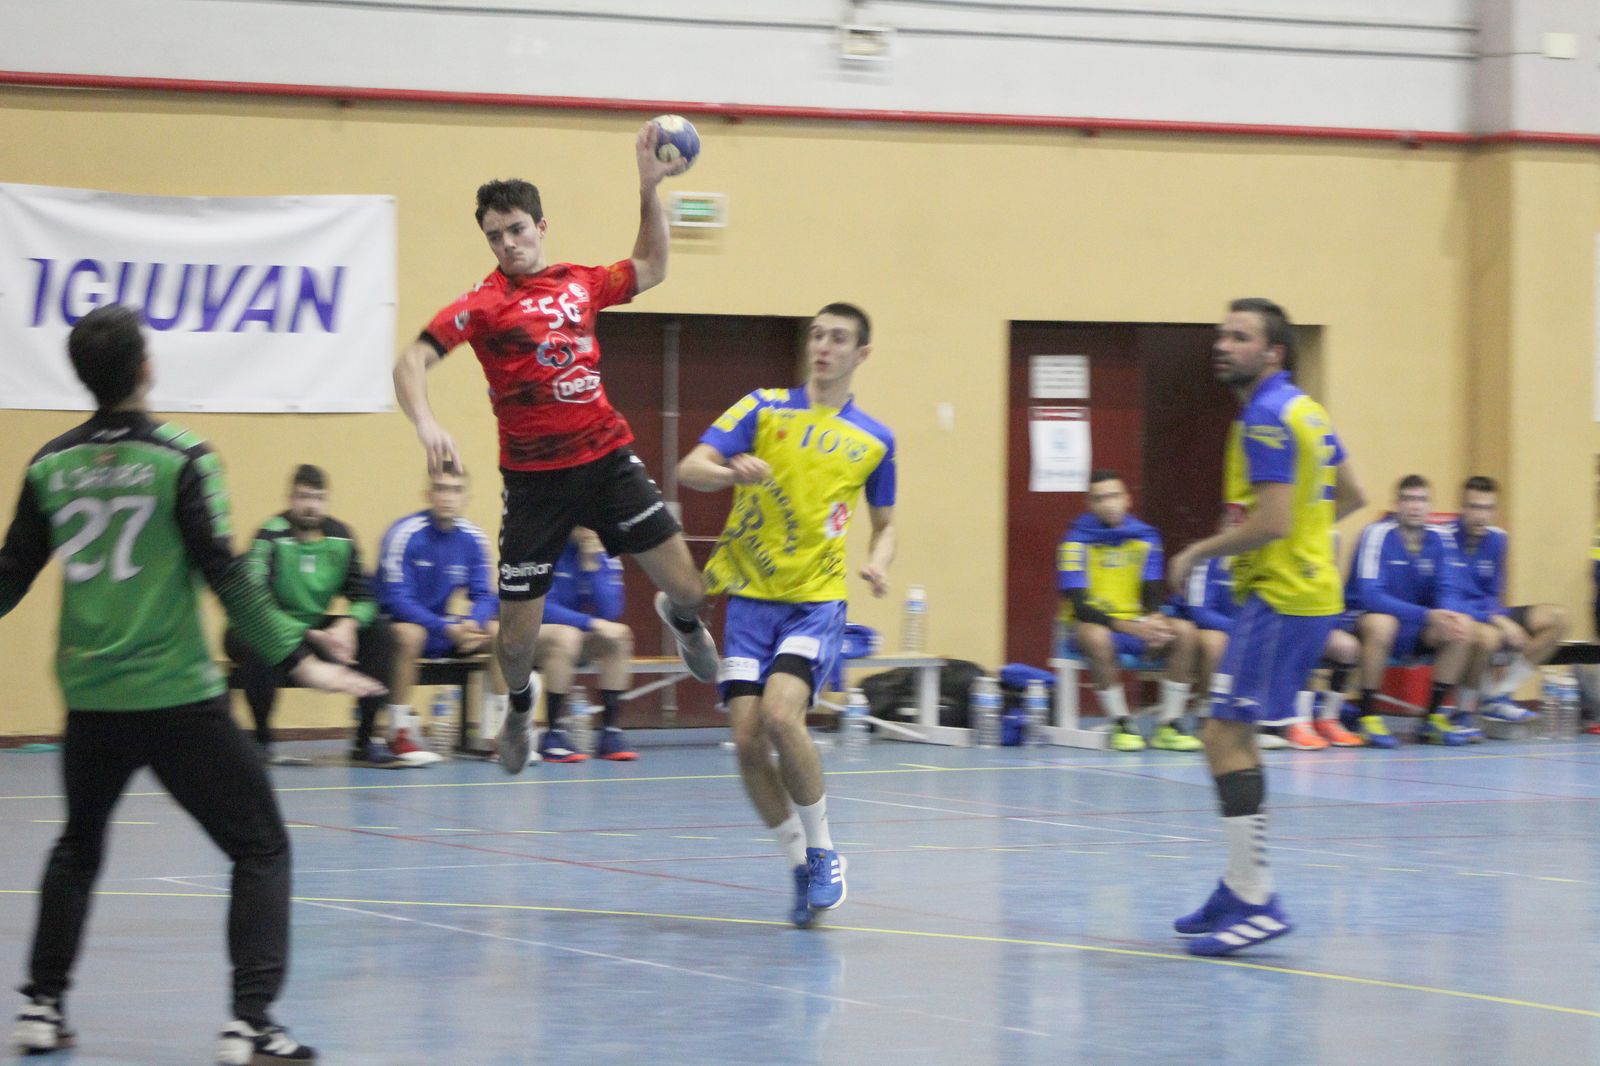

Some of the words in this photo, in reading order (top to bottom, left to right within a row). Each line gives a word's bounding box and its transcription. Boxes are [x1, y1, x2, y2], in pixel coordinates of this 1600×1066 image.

[538, 292, 582, 330] 56
[801, 424, 842, 455] 10
[51, 494, 157, 582] 27
